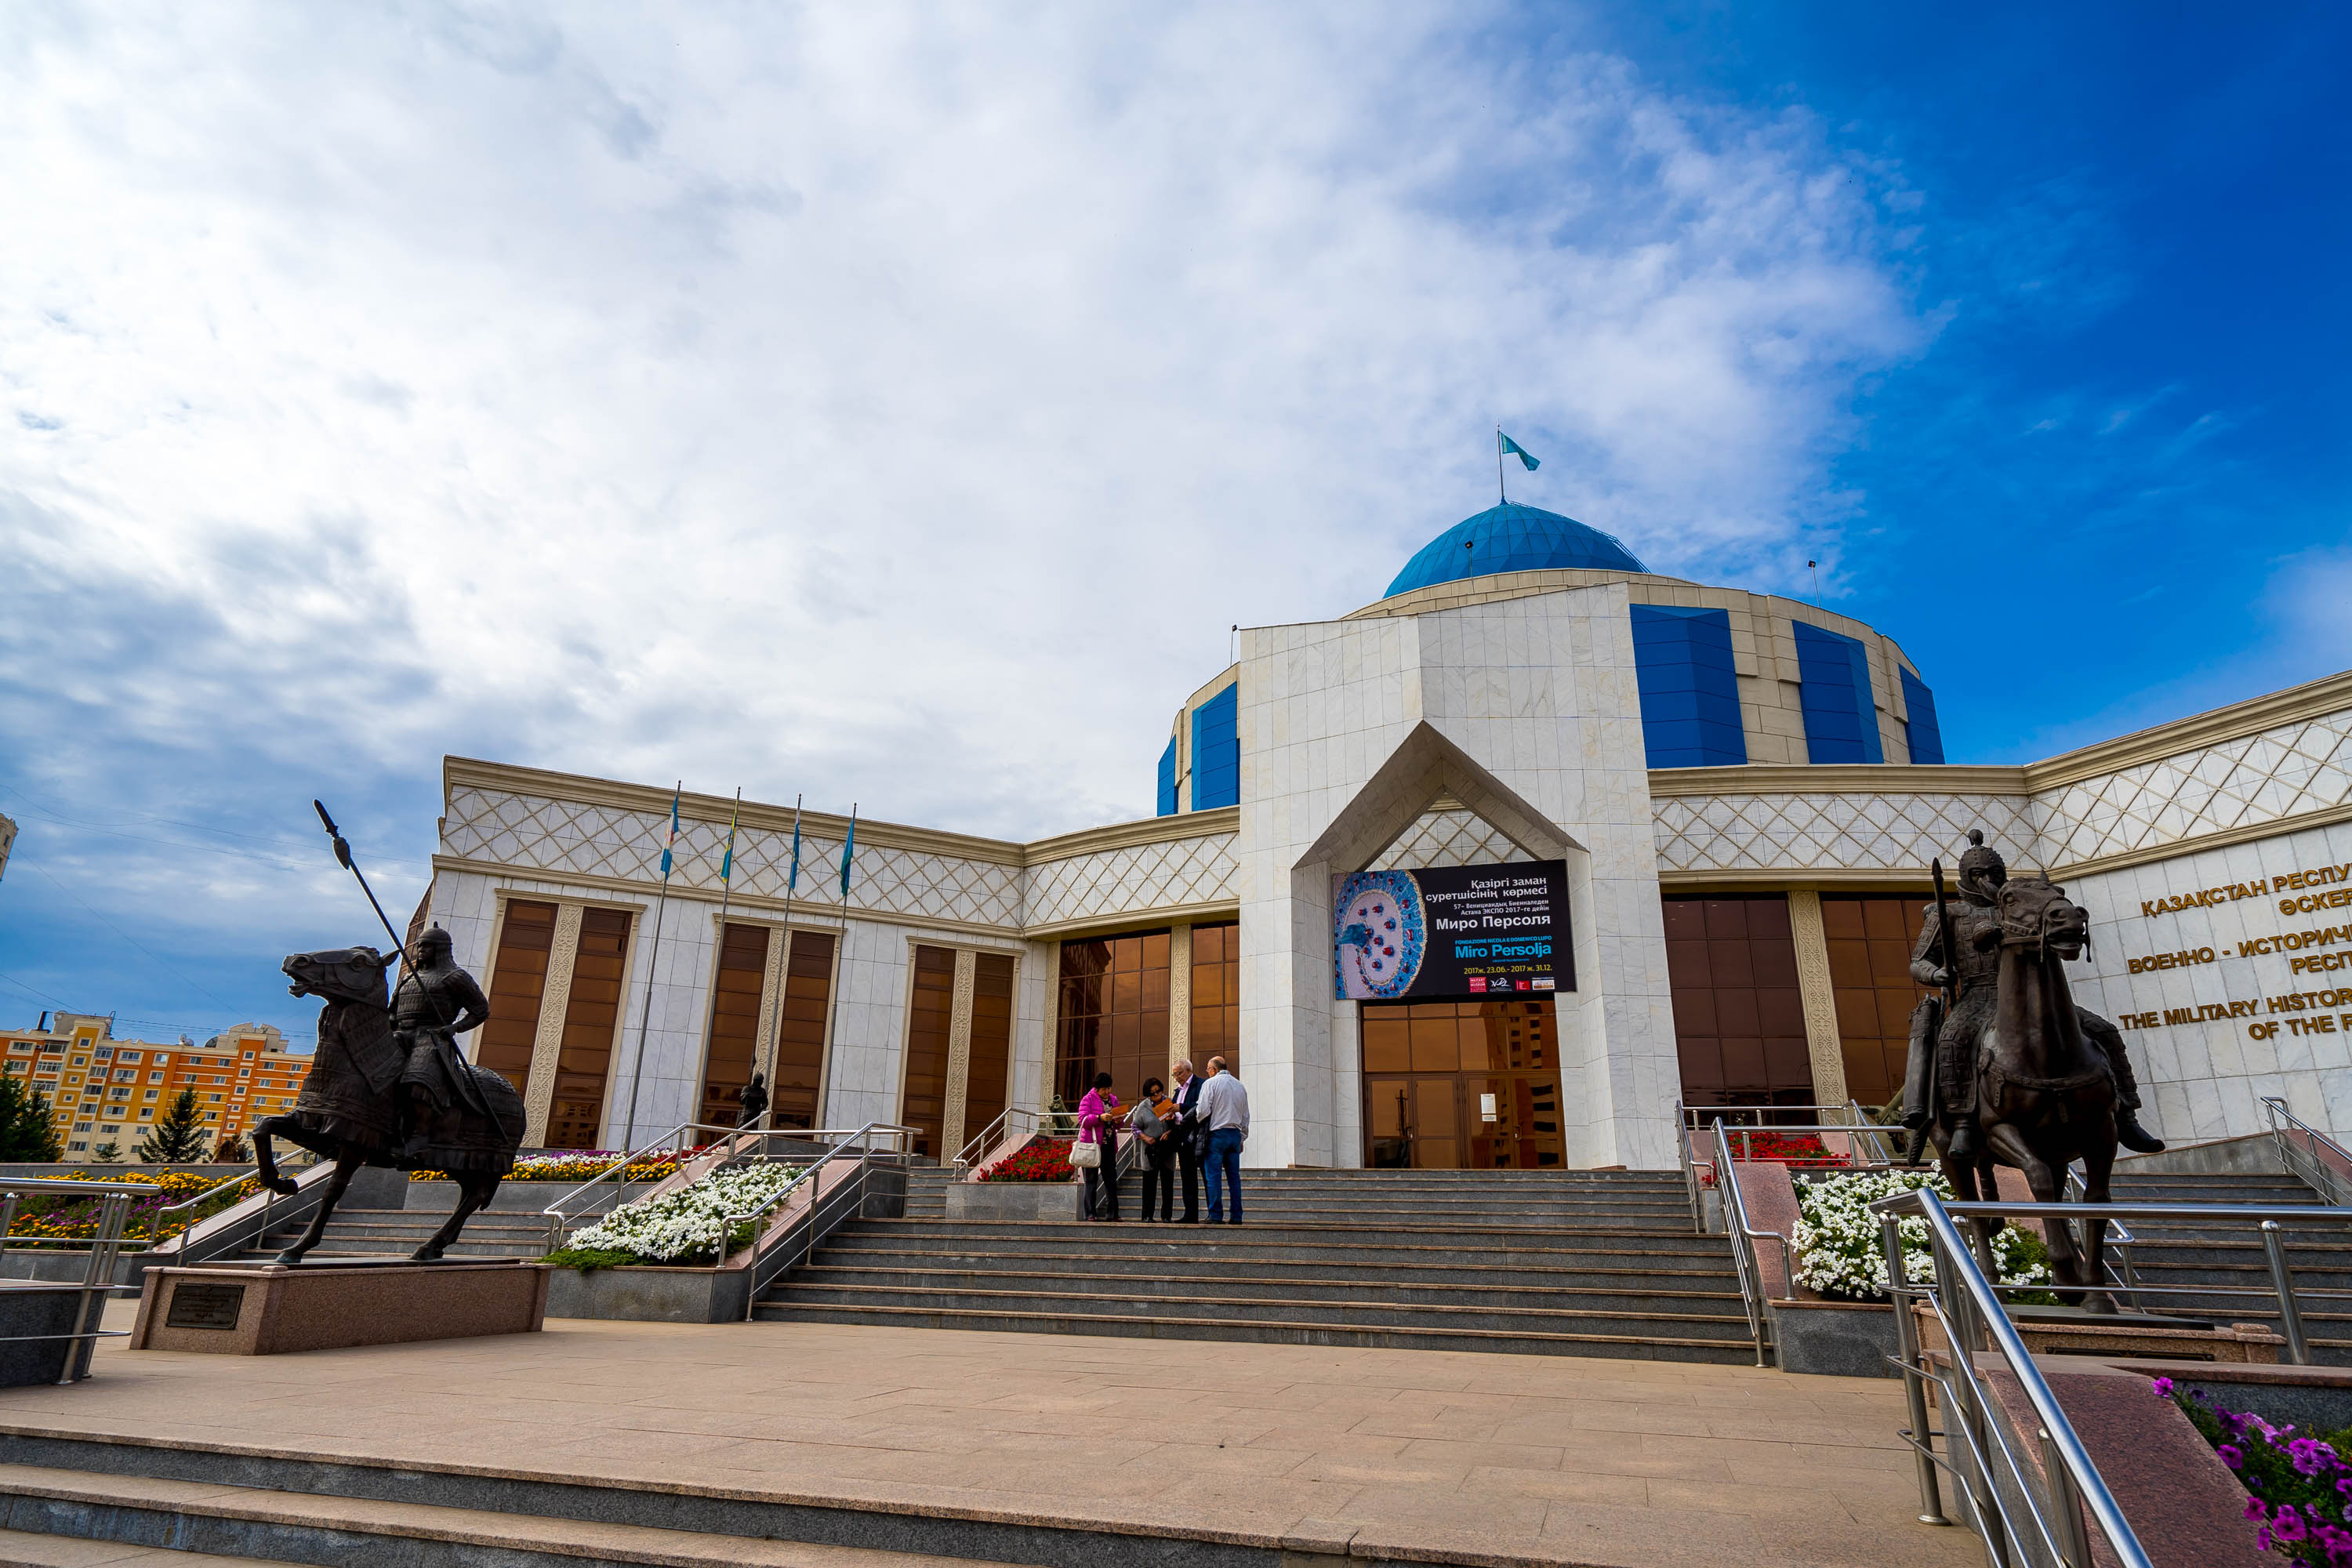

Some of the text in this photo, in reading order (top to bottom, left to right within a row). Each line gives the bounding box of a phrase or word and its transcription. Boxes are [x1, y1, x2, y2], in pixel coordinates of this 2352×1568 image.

[1425, 885, 1548, 902] суретшісінің көрмесі
[1471, 877, 1547, 890] Қазіргі заман
[2141, 862, 2352, 918] ҚАЗАҚСТАН РЕСПУ
[1436, 915, 1551, 931] Миро Персоля
[1455, 942, 1552, 958] Miro Persolja
[2128, 947, 2215, 974] ВОЕННО
[2238, 924, 2352, 957] ИСТОРИЧ
[2119, 988, 2352, 1030] THE MILITARY HISTOR
[2249, 1022, 2279, 1040] OF
[2285, 1015, 2336, 1036] THE
